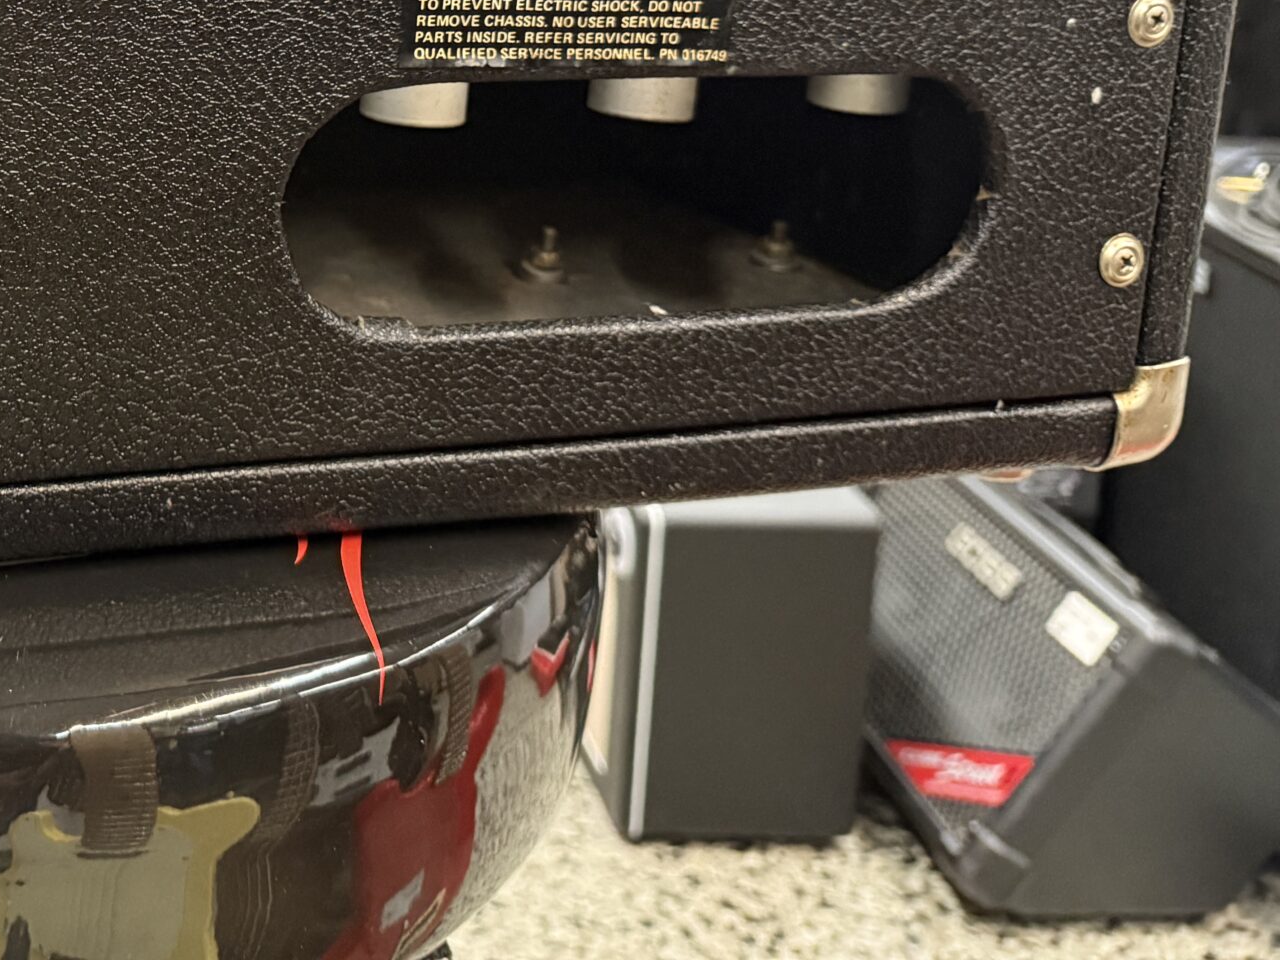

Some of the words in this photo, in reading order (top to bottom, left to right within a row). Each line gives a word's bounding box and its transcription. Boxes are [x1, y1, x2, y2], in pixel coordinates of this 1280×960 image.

[516, 0, 588, 12] ELECTRIC
[591, 0, 644, 13] SHOCK,
[648, 0, 668, 12] DO
[672, 0, 704, 13] NOT
[416, 15, 480, 27] REMOVE
[484, 15, 548, 27] CHASSIS.
[552, 16, 574, 27] NO
[577, 16, 616, 28] USER
[621, 16, 720, 30] SERVICEABLE
[415, 31, 462, 43] PARTS
[467, 31, 520, 43] INSIDE.
[524, 32, 573, 43] REFER
[576, 32, 656, 44] SERVICING
[660, 33, 680, 44] TO
[414, 48, 497, 60] QUALIFIED
[500, 48, 562, 60] SERVICE
[567, 48, 654, 60] PERSONNEL.
[659, 49, 677, 60] PN
